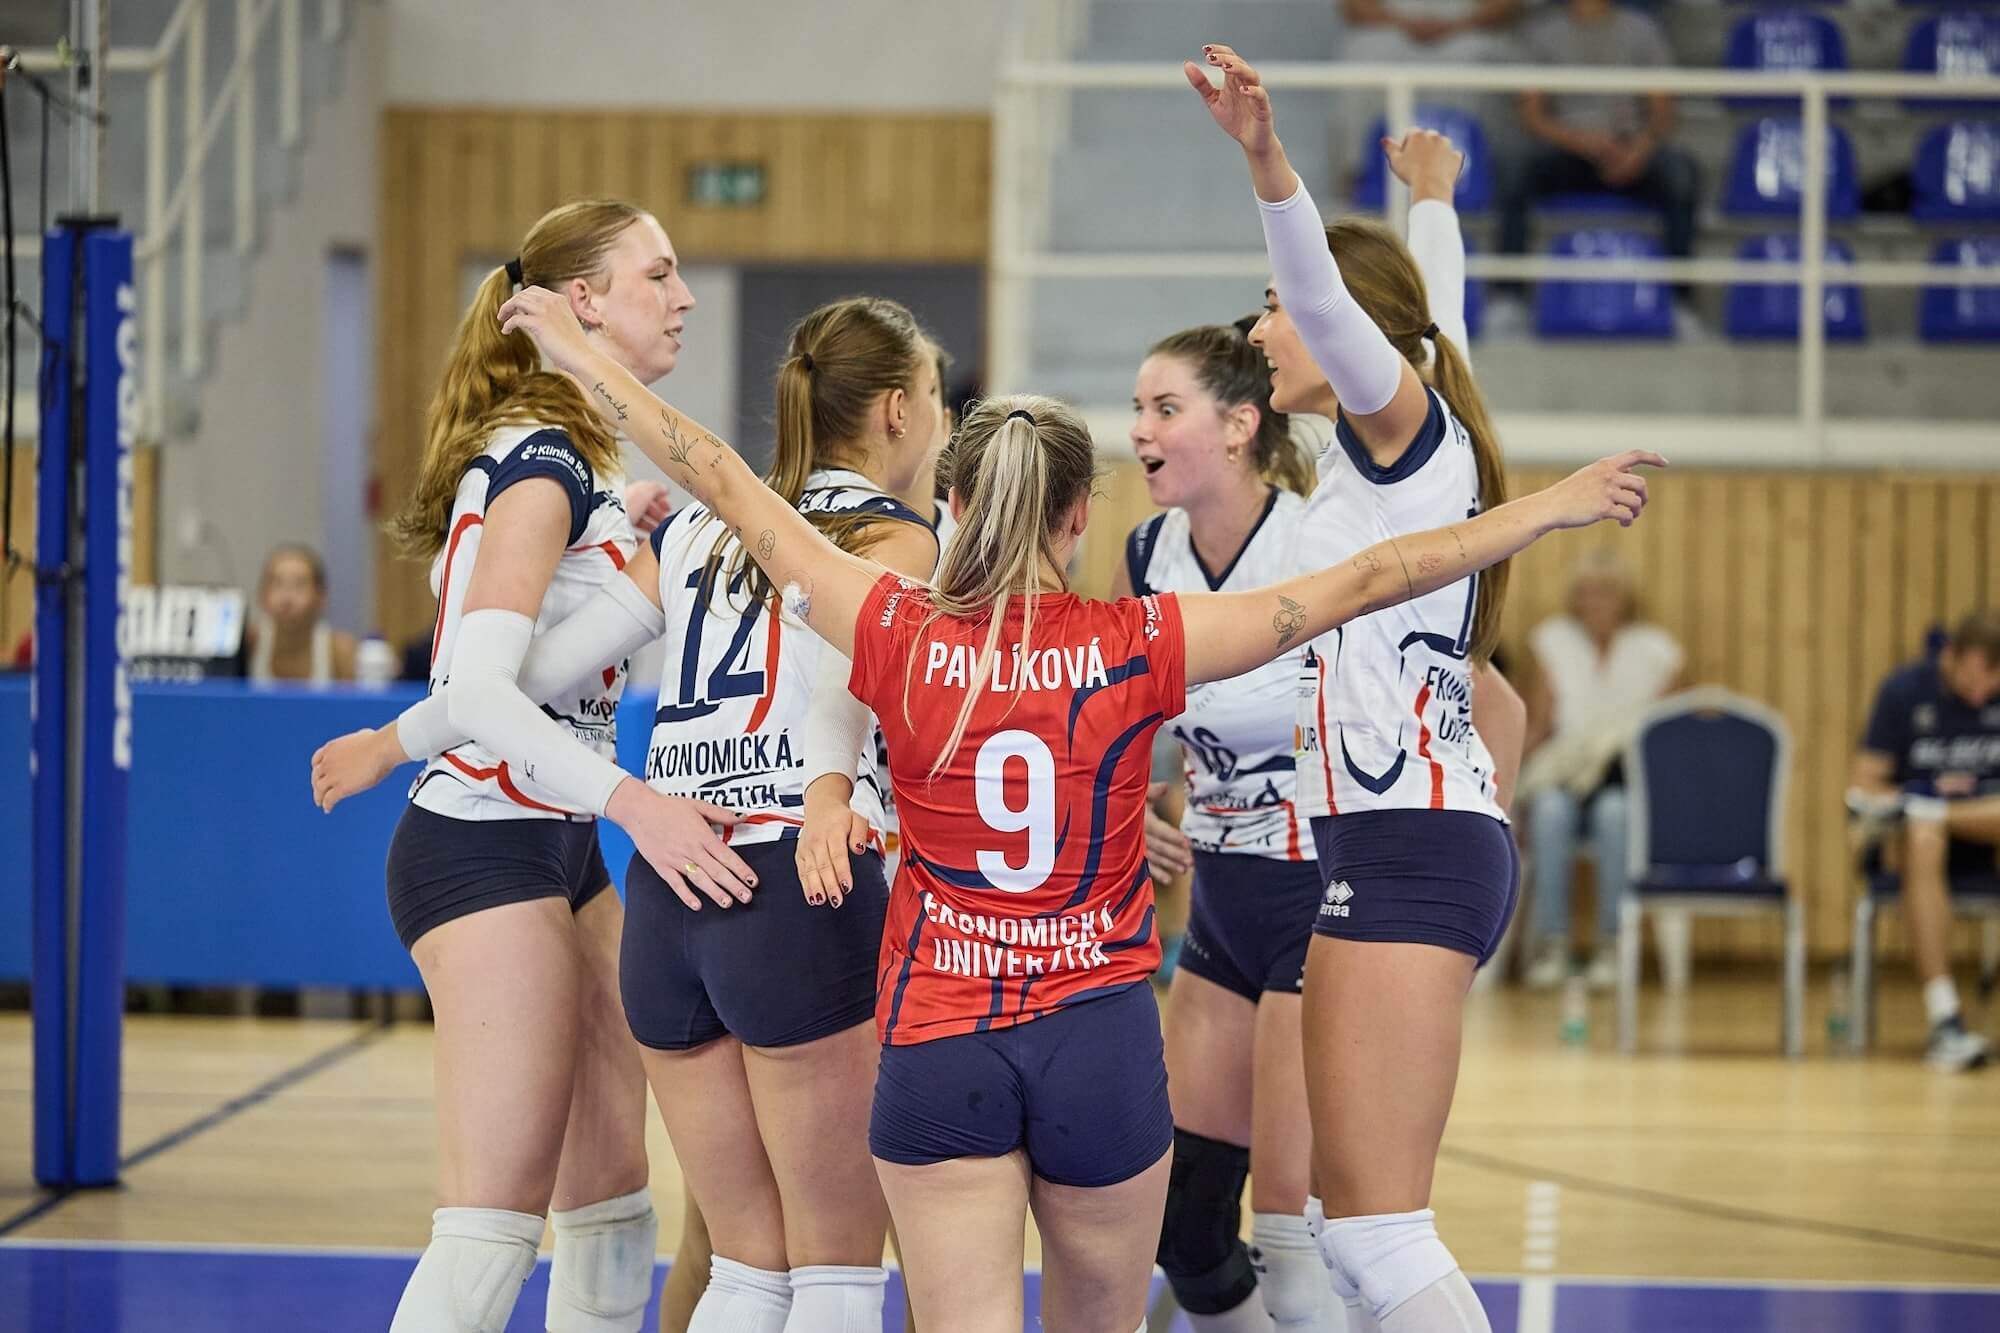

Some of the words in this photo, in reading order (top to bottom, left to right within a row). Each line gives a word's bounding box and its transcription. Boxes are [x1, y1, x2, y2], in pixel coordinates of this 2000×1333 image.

[593, 381, 628, 420] family
[538, 445, 575, 465] Klinika
[679, 555, 764, 706] 12
[925, 637, 1109, 692] PAVLÍKOVÁ
[975, 729, 1055, 892] 9
